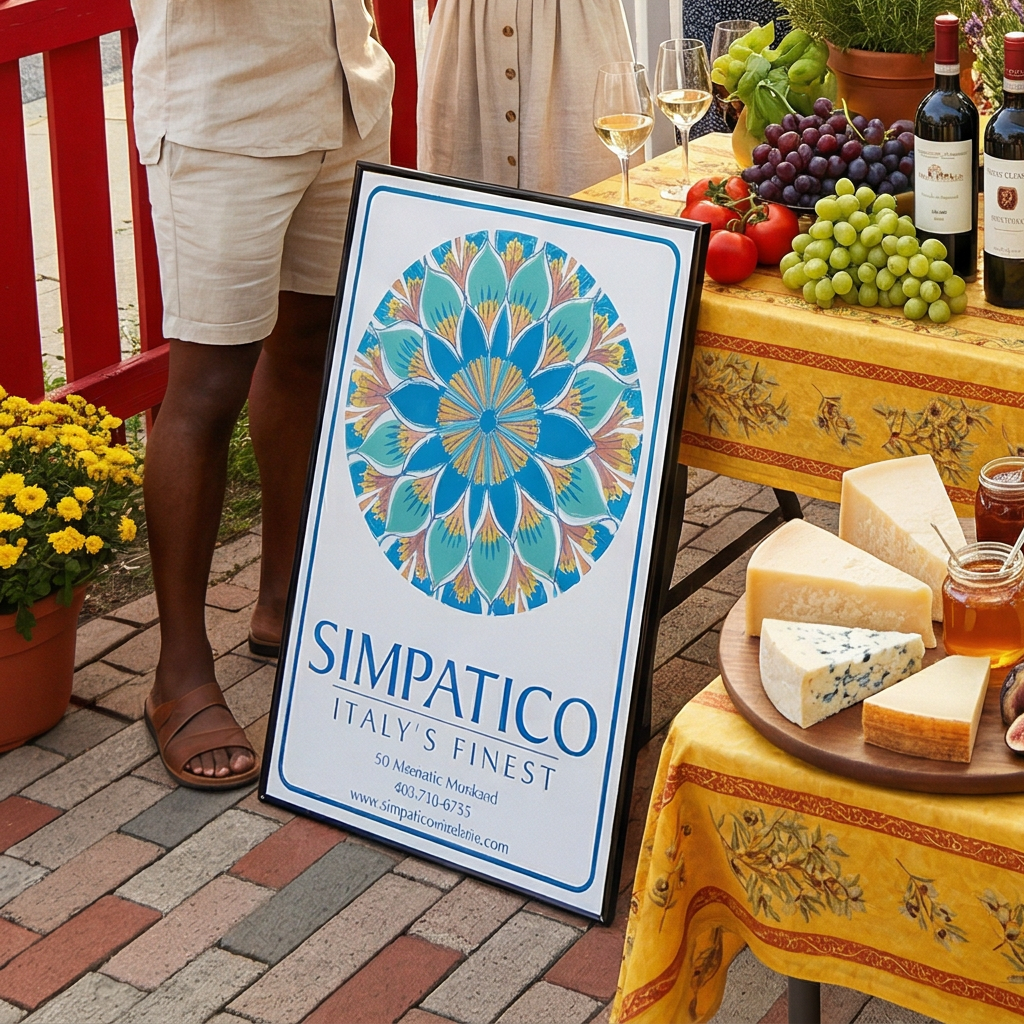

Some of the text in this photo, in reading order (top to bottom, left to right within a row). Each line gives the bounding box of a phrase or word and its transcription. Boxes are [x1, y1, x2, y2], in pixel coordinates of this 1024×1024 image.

[308, 619, 598, 758] SIMPATICO
[333, 696, 556, 792] ITALY'S FINEST
[373, 752, 390, 768] 50
